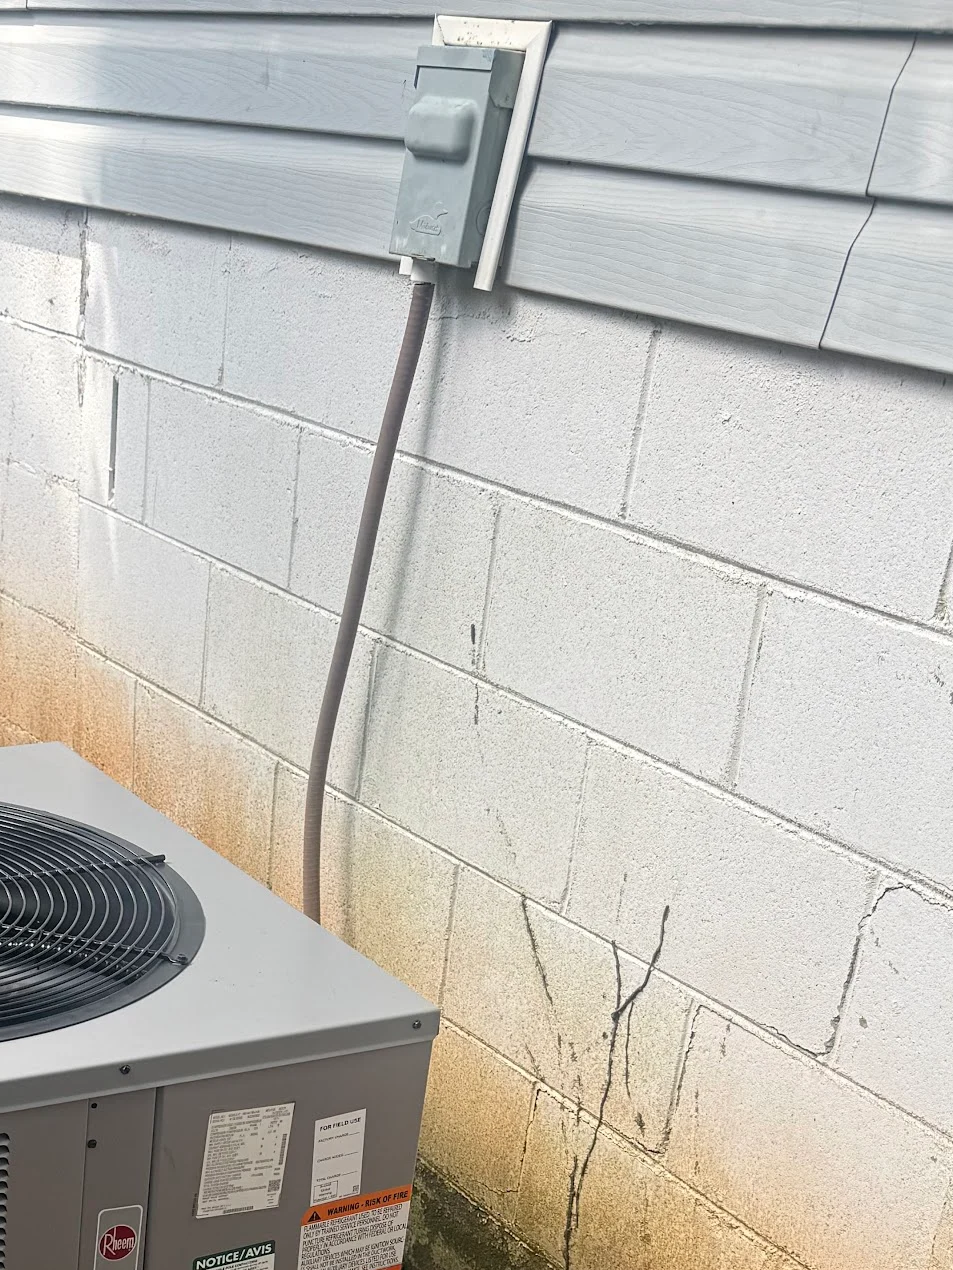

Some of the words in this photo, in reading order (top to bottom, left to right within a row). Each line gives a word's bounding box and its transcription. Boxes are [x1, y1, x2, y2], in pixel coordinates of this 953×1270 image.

[333, 1119, 348, 1128] FIELD
[327, 1203, 359, 1215] WARNING
[365, 1197, 381, 1206] RISK
[383, 1194, 391, 1202] OF
[393, 1190, 407, 1200] FIRE
[103, 1227, 135, 1256] Rheem
[196, 1243, 271, 1269] NOTICE/AVIS
